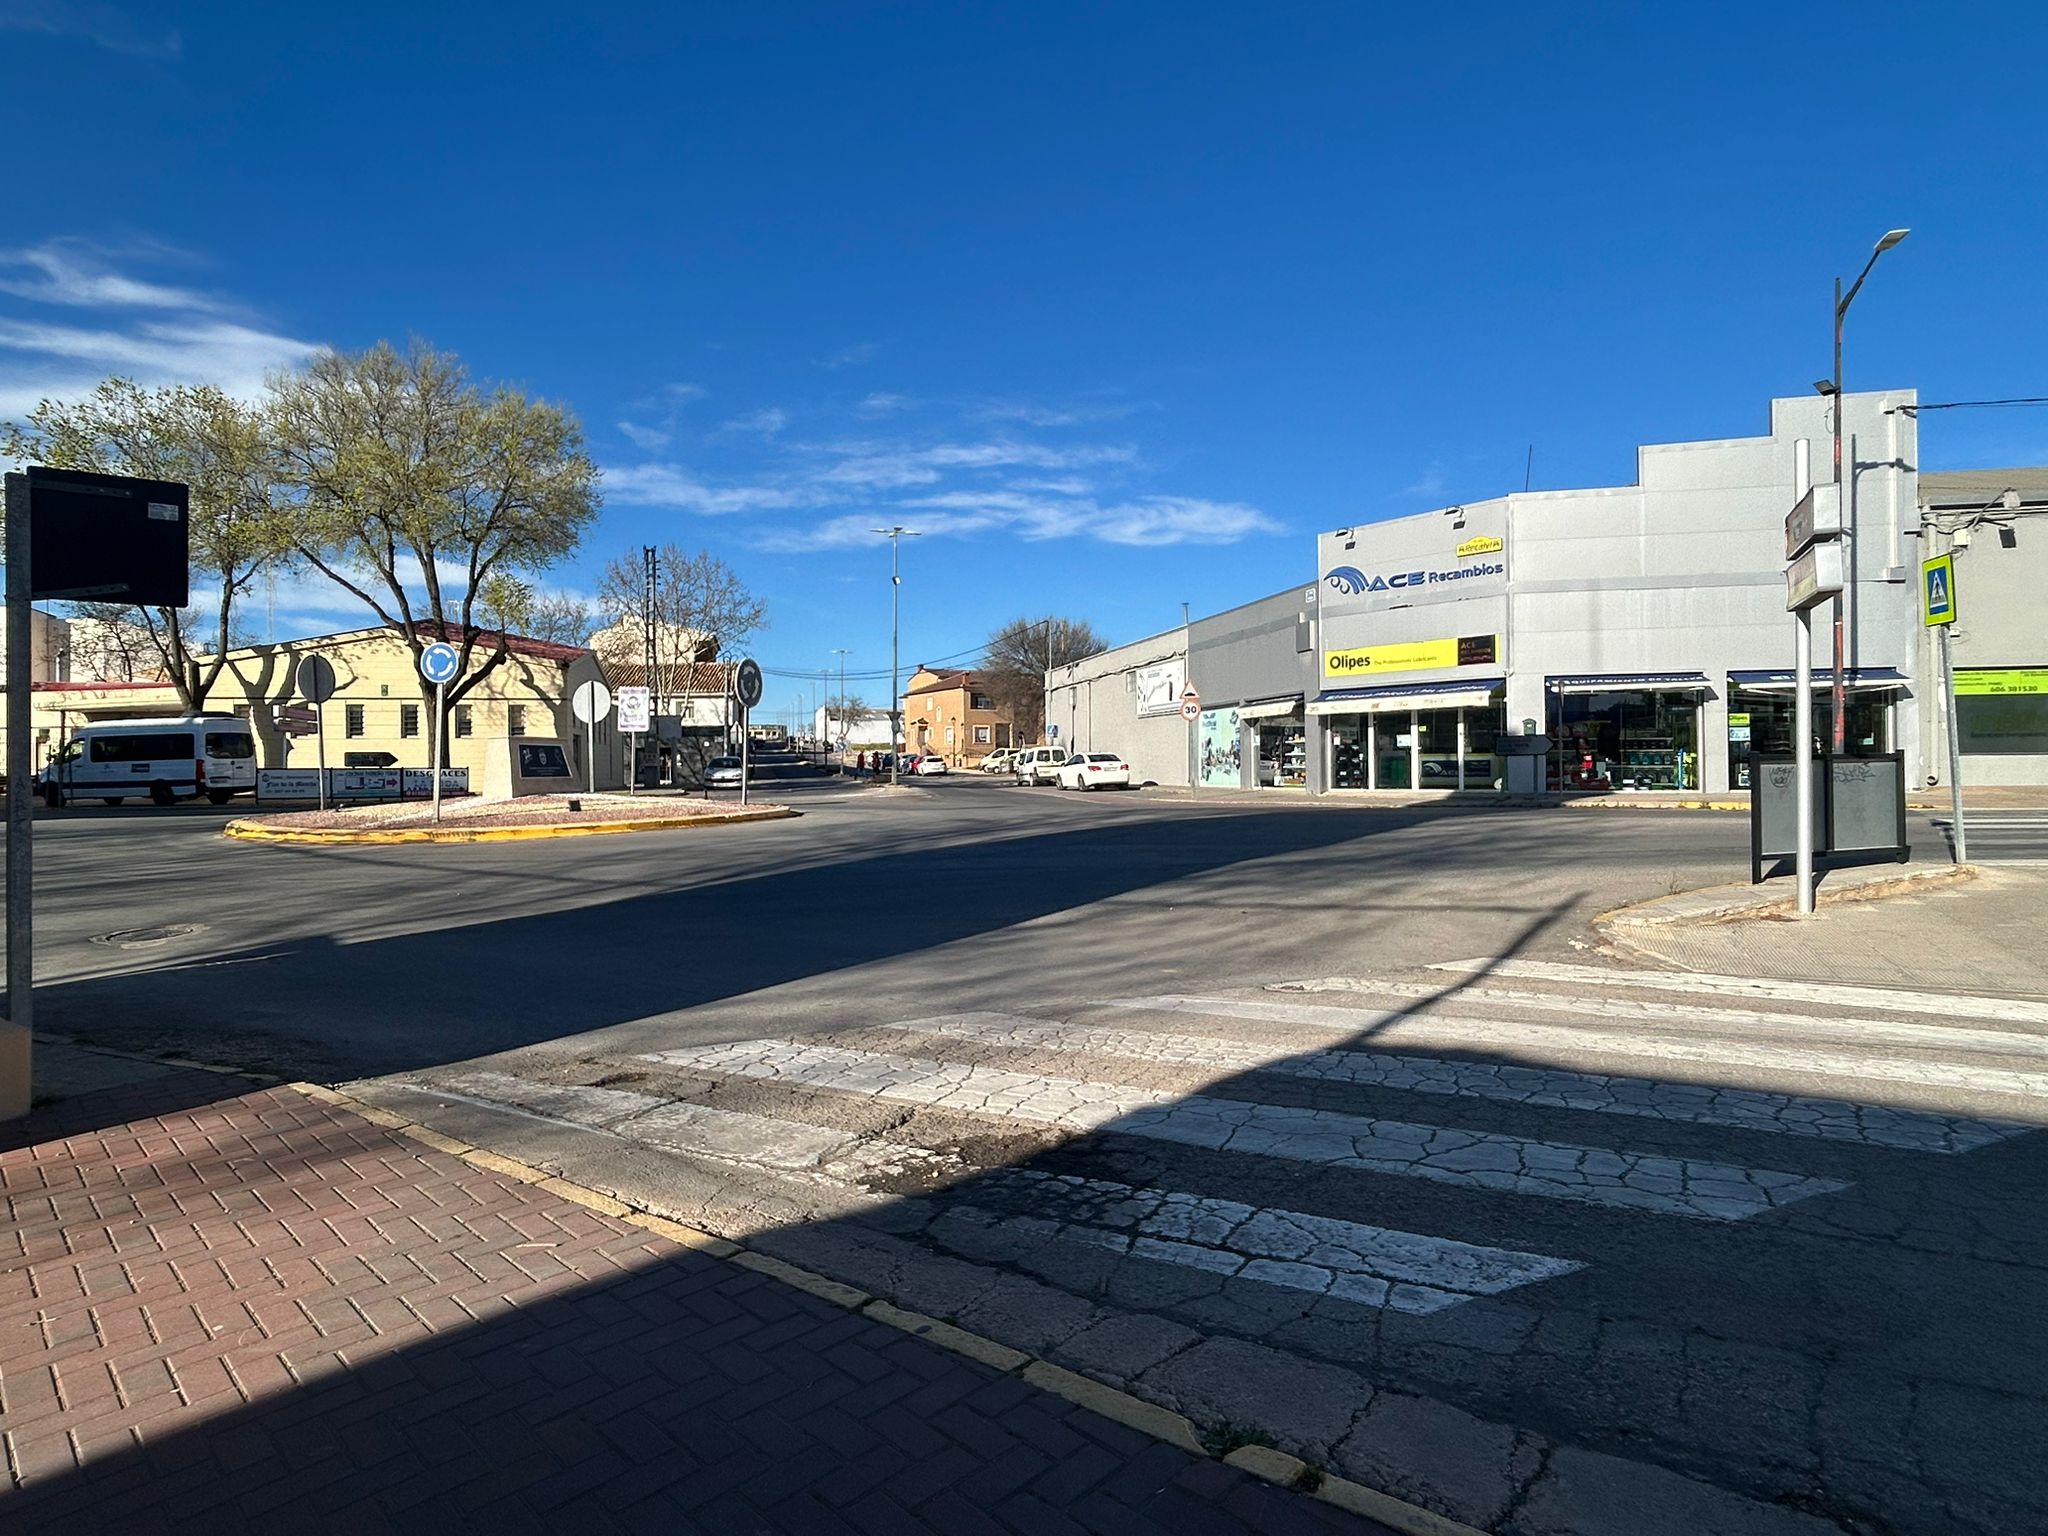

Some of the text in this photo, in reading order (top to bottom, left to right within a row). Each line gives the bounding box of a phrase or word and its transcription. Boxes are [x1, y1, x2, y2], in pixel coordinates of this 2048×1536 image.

[1367, 563, 1503, 592] ACE Recambios
[1329, 655, 1371, 670] Olipes
[1184, 706, 1197, 714] 30
[404, 769, 467, 778] DESGACES
